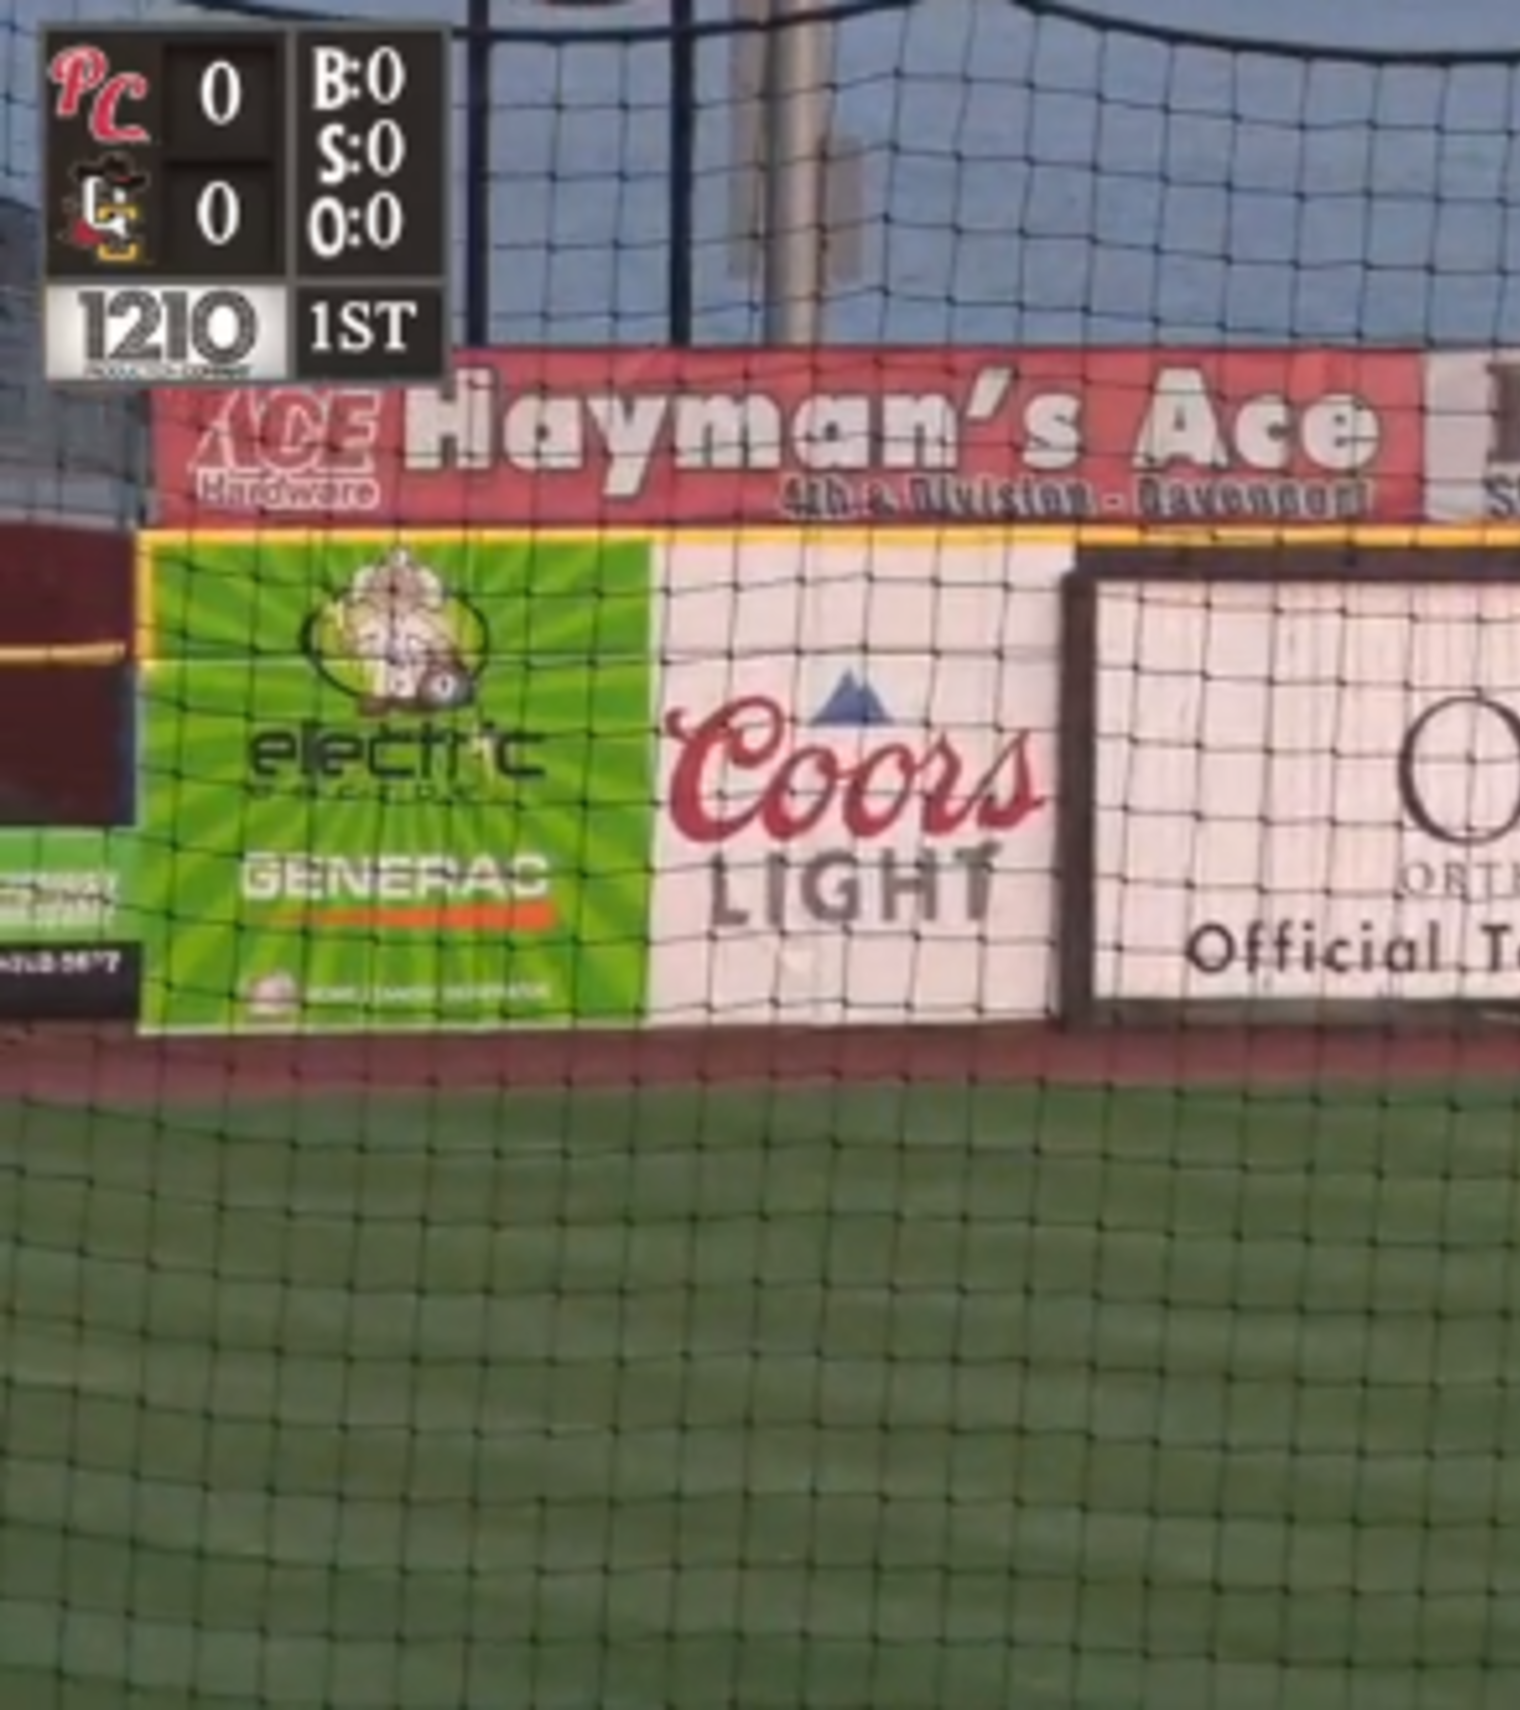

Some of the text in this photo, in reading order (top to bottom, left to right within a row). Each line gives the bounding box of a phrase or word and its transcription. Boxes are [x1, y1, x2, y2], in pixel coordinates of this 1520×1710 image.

[403, 366, 1380, 496] Hayman's Ace
[197, 468, 381, 511] Hardware
[664, 696, 1048, 842] Coors
[240, 853, 550, 901] GENERAC
[710, 842, 1002, 926] LIGHT
[1186, 919, 1441, 975] Official
